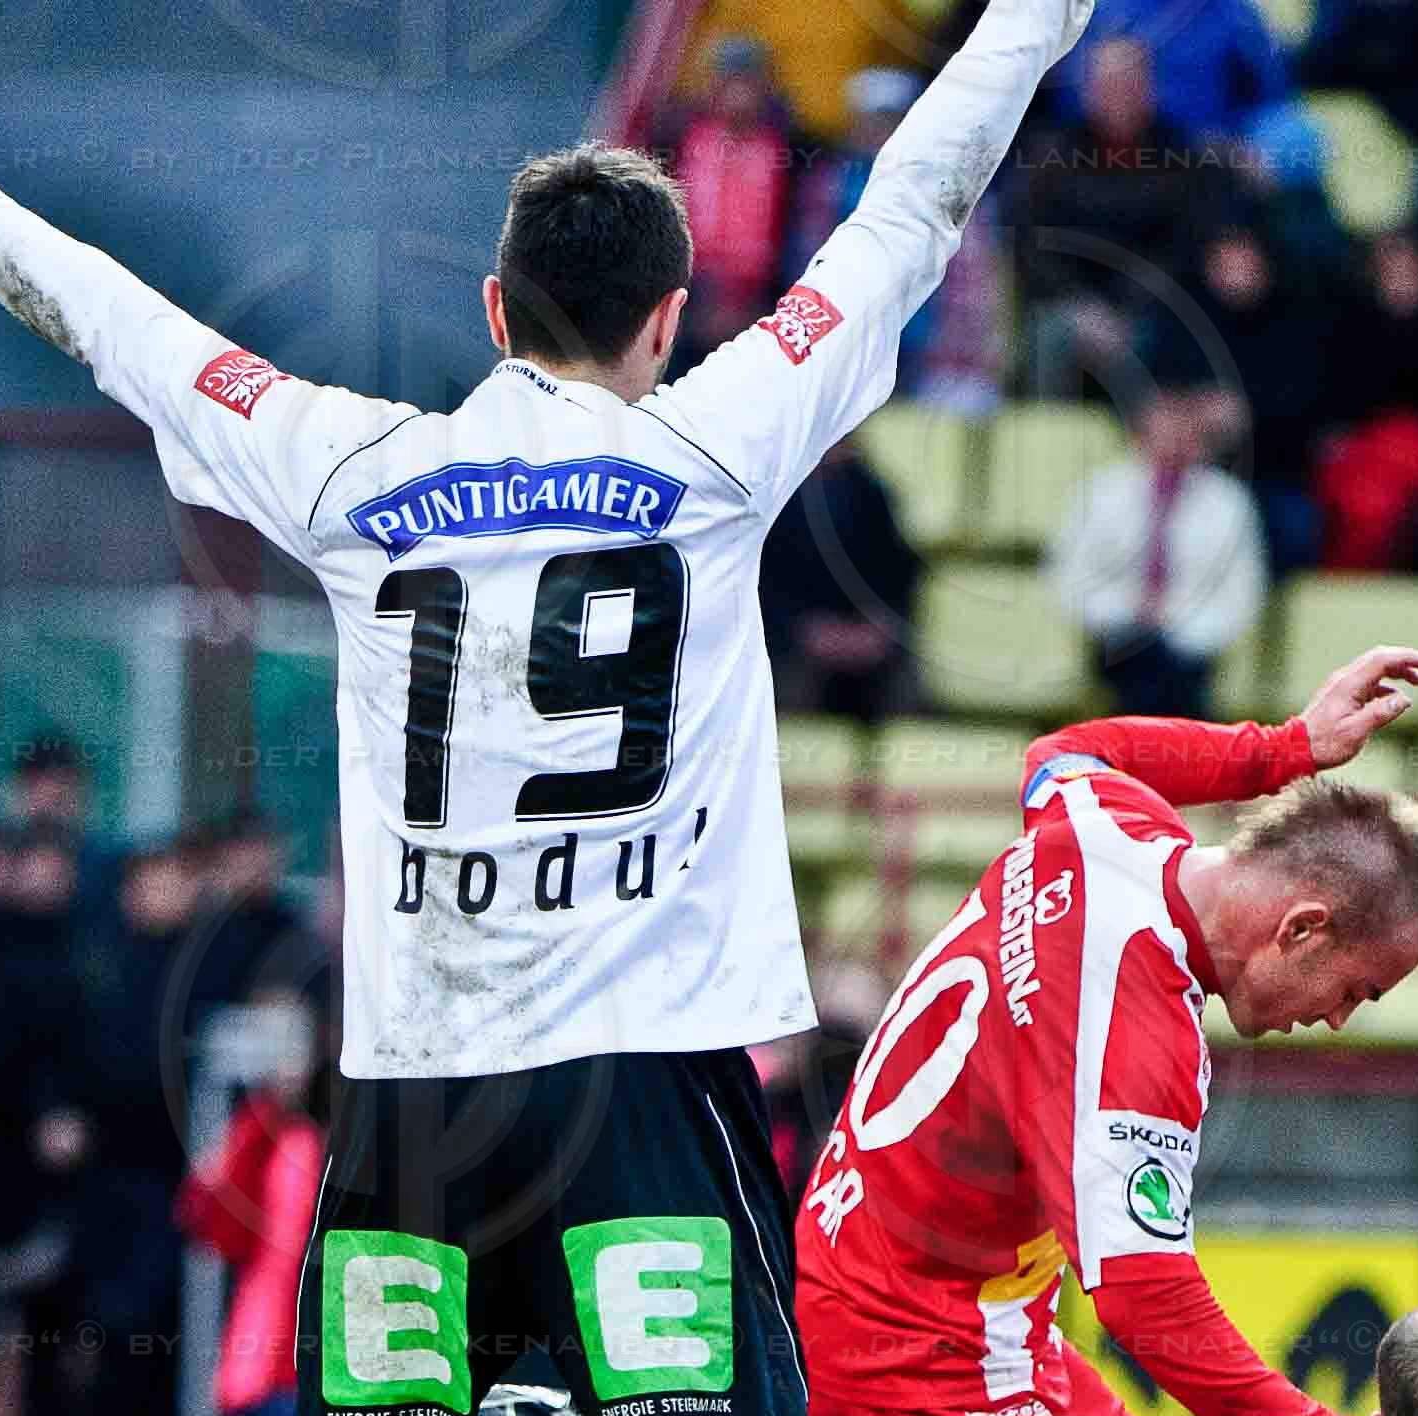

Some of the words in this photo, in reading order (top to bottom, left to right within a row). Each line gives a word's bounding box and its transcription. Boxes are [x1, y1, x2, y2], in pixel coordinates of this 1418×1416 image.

[365, 472, 662, 546] PUNTIGAMER
[373, 541, 690, 830] 19
[1108, 1120, 1194, 1155] ŠKODA
[343, 1254, 452, 1385] E
[594, 1240, 711, 1371] E
[660, 1397, 733, 1415] STEIERMARK
